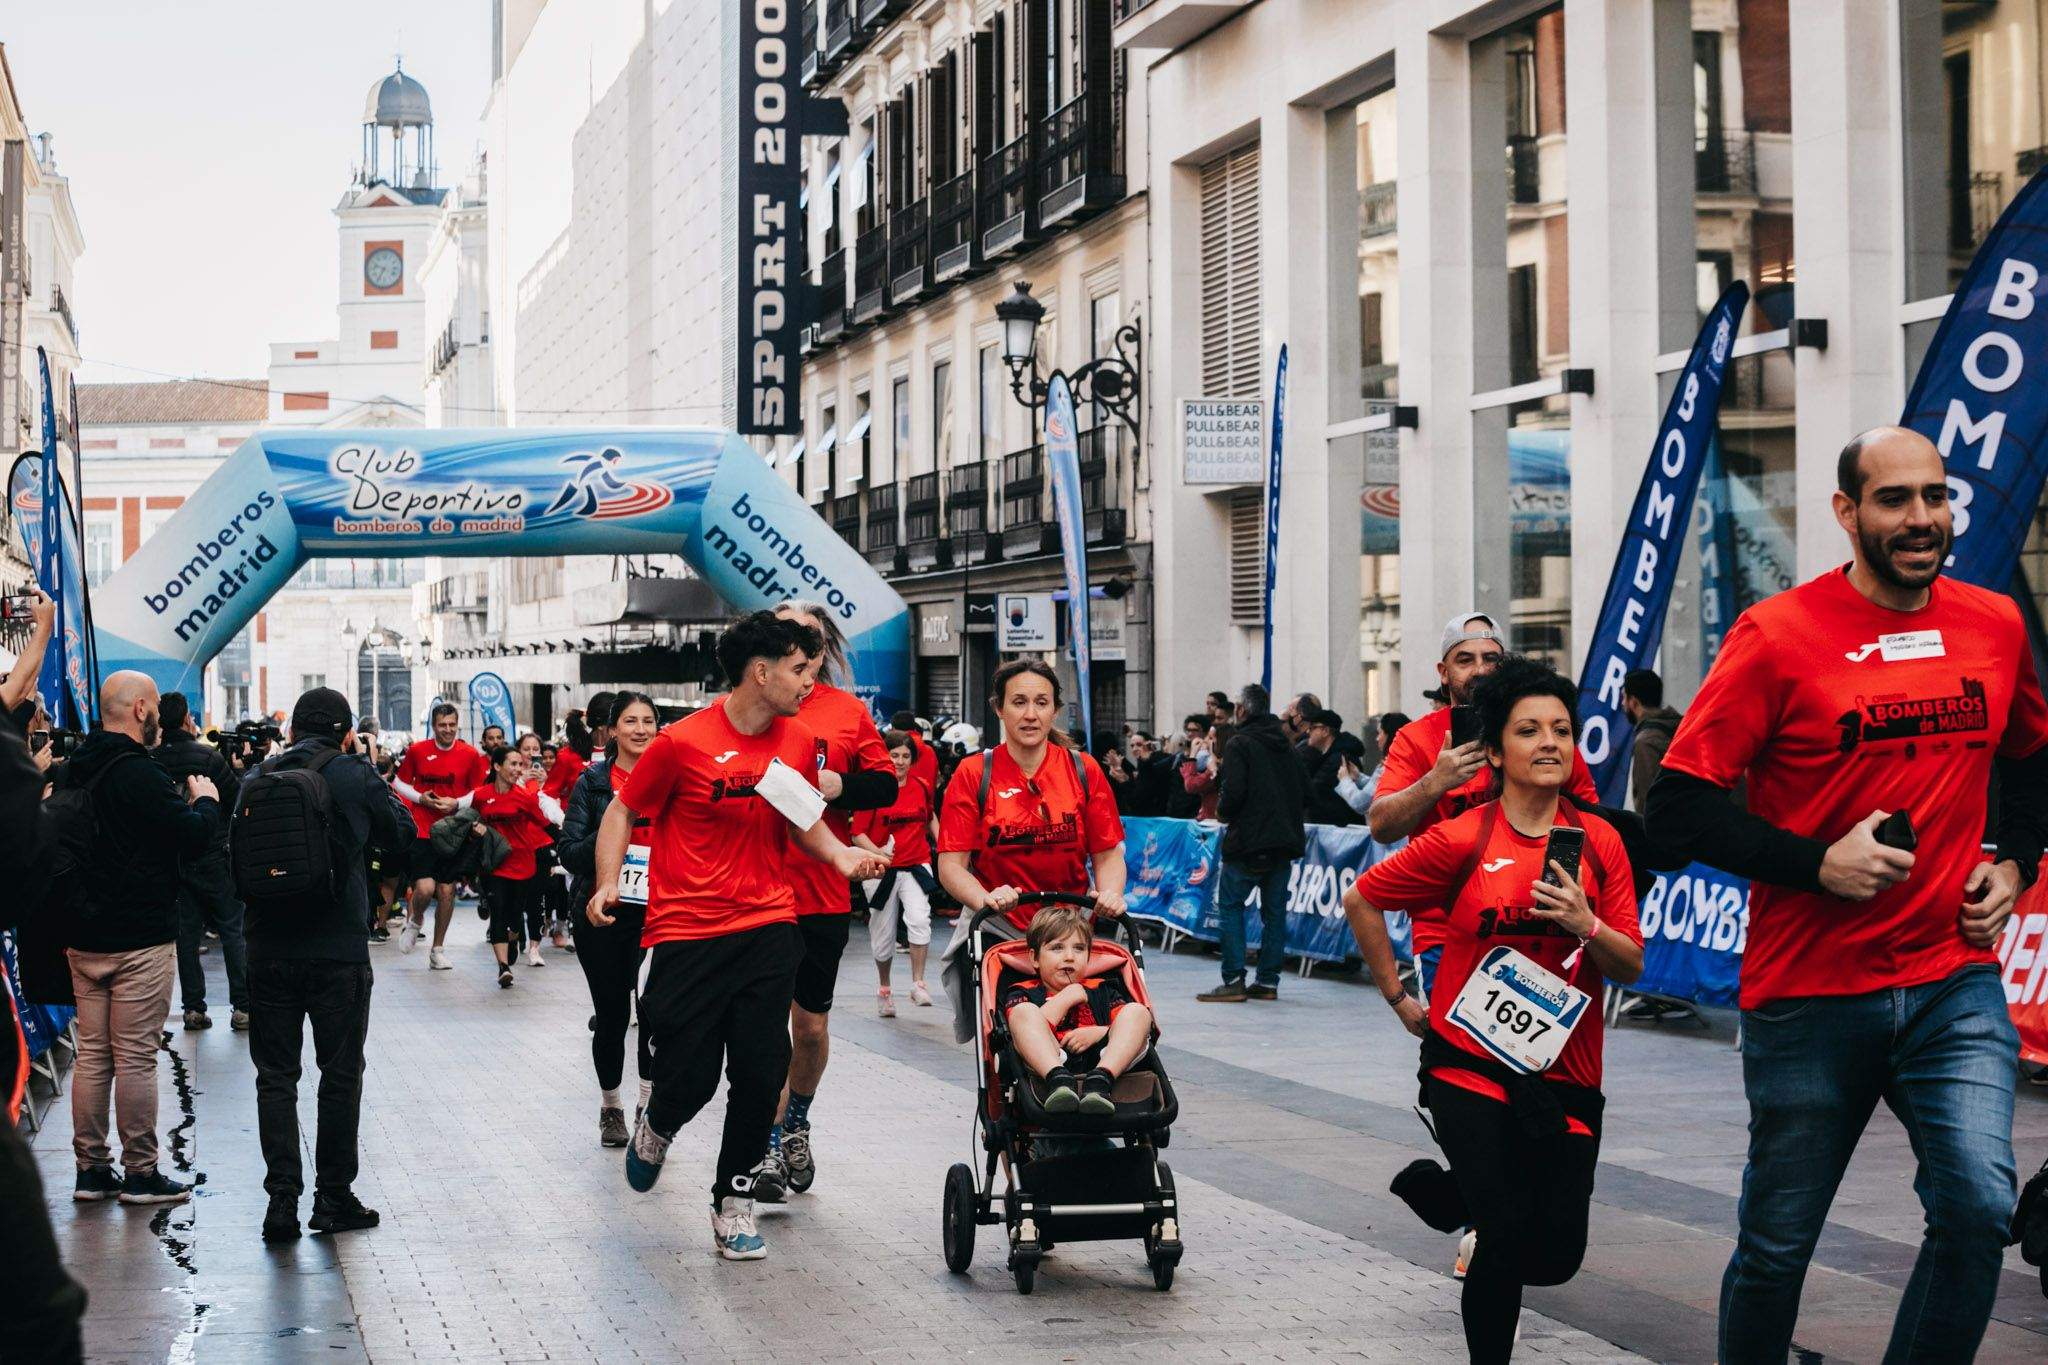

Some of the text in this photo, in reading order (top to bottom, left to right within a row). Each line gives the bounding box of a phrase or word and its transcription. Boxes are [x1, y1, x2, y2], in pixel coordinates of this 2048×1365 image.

[753, 0, 787, 427] SPORT 2000
[1186, 405, 1260, 416] PULL&BEAR
[1186, 421, 1260, 432] PULL&BEAR
[1938, 257, 2038, 567] BOMB
[336, 449, 415, 475] Club
[1186, 436, 1260, 448] PULL&BEAR
[352, 474, 522, 519] Deportivo
[336, 516, 522, 533] bomberos de madrid
[144, 491, 275, 615] bomberos
[704, 524, 799, 602] madri
[731, 492, 857, 619] bomberos
[1581, 371, 1700, 766] BOMBERO
[174, 534, 279, 642] madrid
[1874, 697, 1984, 721] BOMBEROS
[1920, 711, 1985, 734] de MADRID
[623, 869, 650, 887] 17
[1514, 972, 1565, 1008] BOMBEROS
[1484, 989, 1551, 1043] 1697
